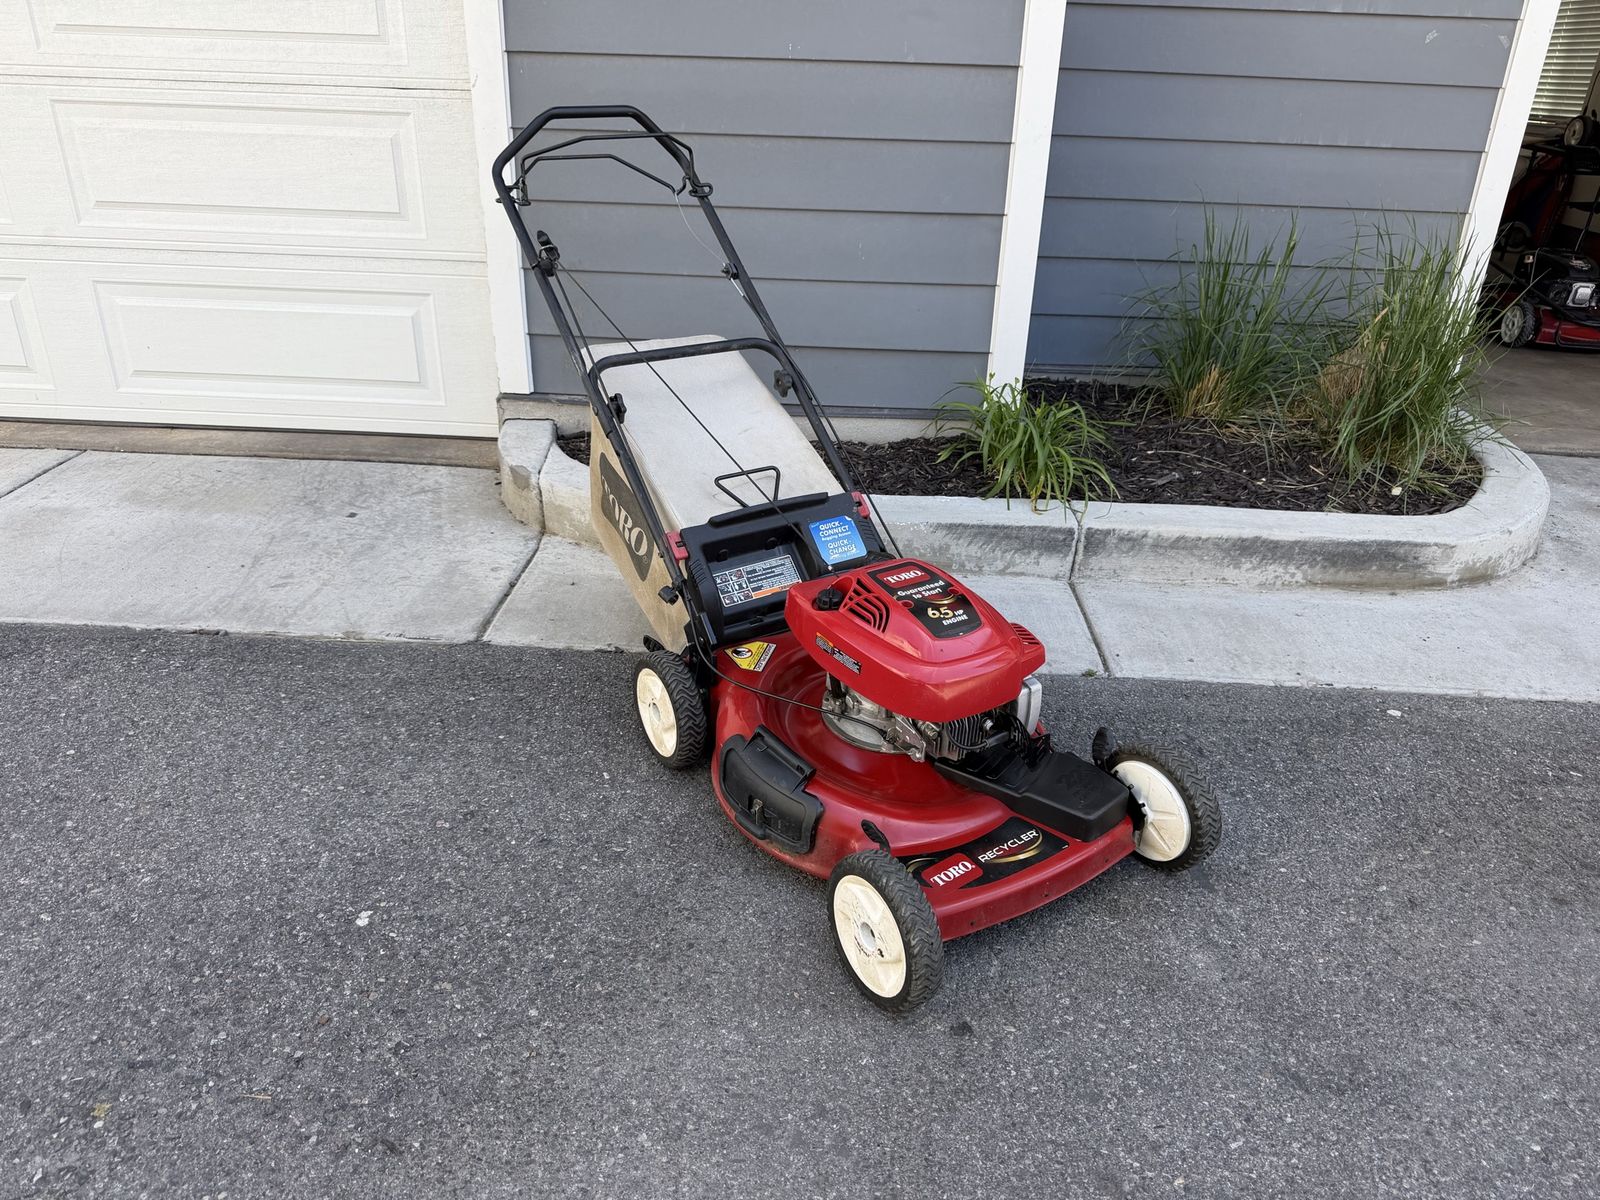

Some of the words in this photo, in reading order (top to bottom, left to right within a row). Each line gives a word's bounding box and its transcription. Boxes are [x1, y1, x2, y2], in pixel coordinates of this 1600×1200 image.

[819, 525, 849, 537] CONNECT
[884, 569, 922, 584] TORO
[897, 580, 946, 597] Guaranteed
[912, 592, 923, 600] to
[923, 587, 943, 597] Start
[927, 606, 954, 619] 6.5
[942, 614, 969, 626] ENGINE
[978, 829, 1040, 863] RECYCLER
[930, 860, 973, 887] TORO
